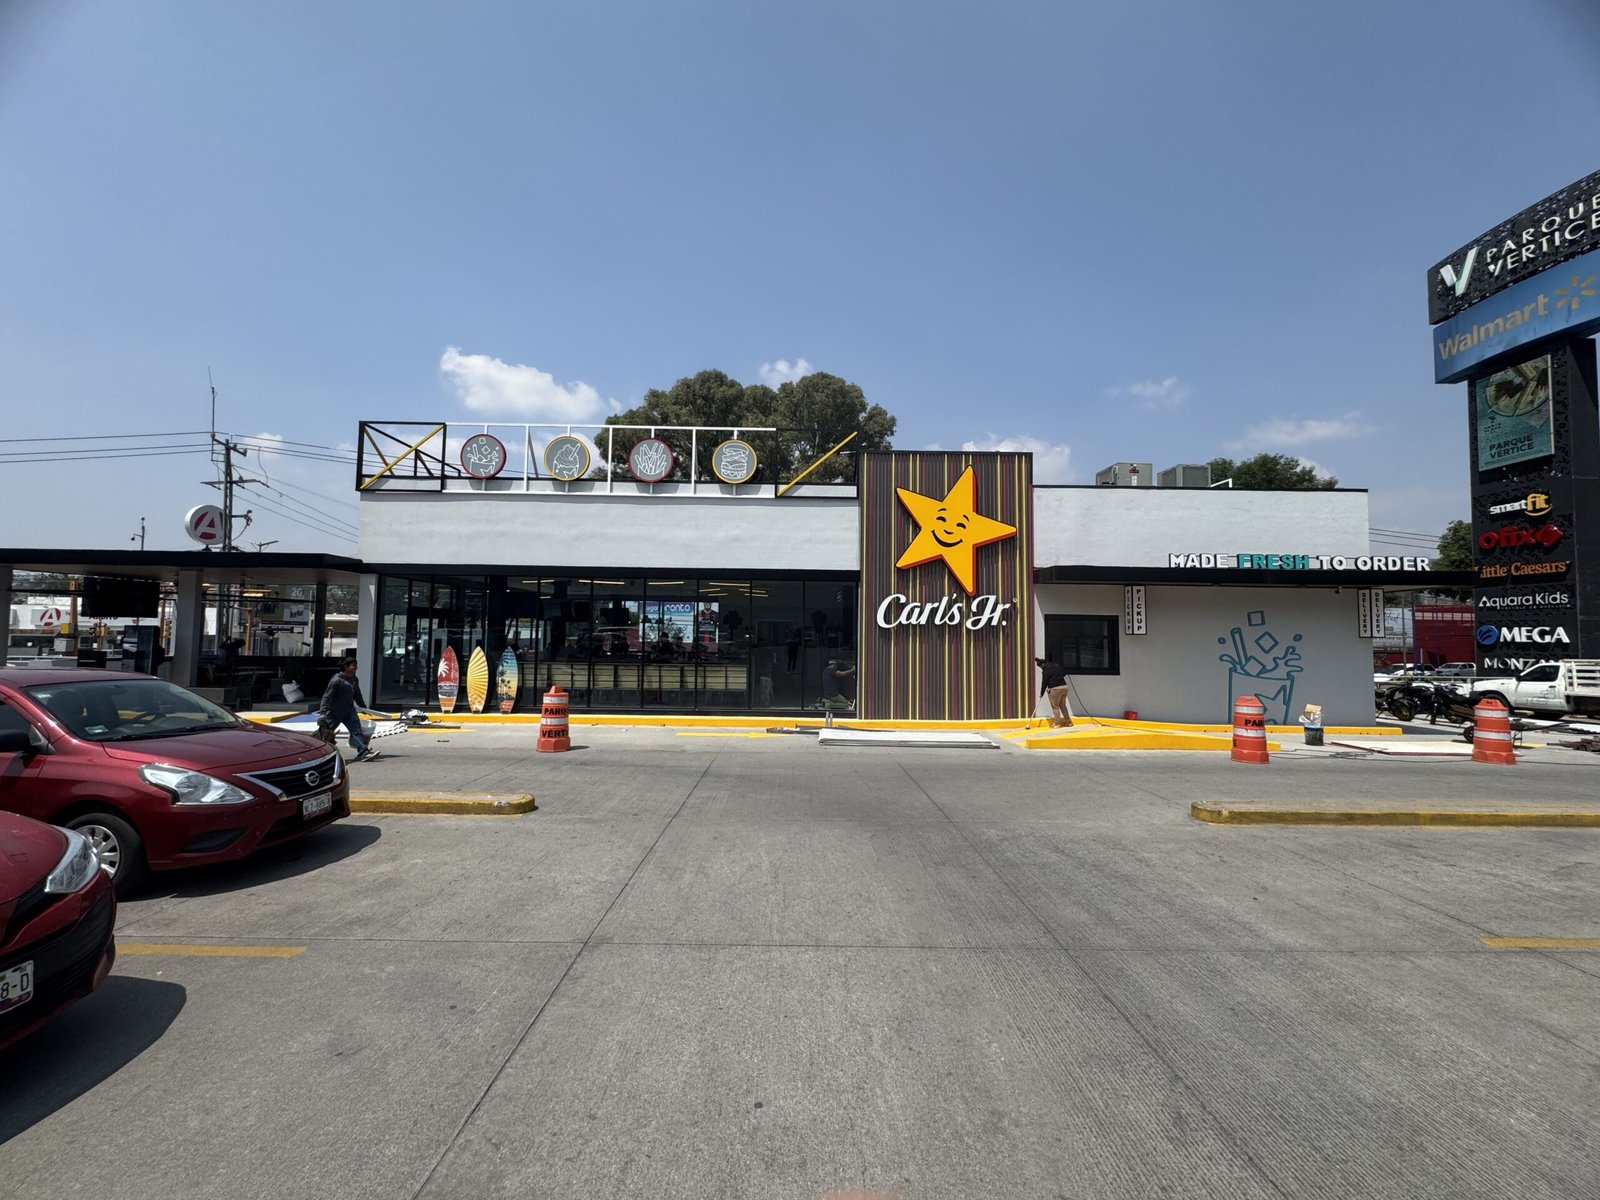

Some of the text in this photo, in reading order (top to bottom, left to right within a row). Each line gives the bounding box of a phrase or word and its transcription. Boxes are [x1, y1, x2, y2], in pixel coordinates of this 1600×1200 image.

[1486, 194, 1600, 263] PARQUE
[1488, 211, 1600, 277] VERTICE
[1439, 293, 1549, 360] Walmart
[1489, 433, 1534, 451] PARQUE
[1489, 442, 1535, 459] VERTICE
[1169, 553, 1430, 571] MADE FRESH TO ORDER
[1511, 561, 1567, 575] Caesars
[1479, 596, 1533, 610] Aquara
[1536, 591, 1569, 605] Kids
[876, 593, 1012, 630] Carl's Jr.
[1500, 626, 1571, 643] MEGA
